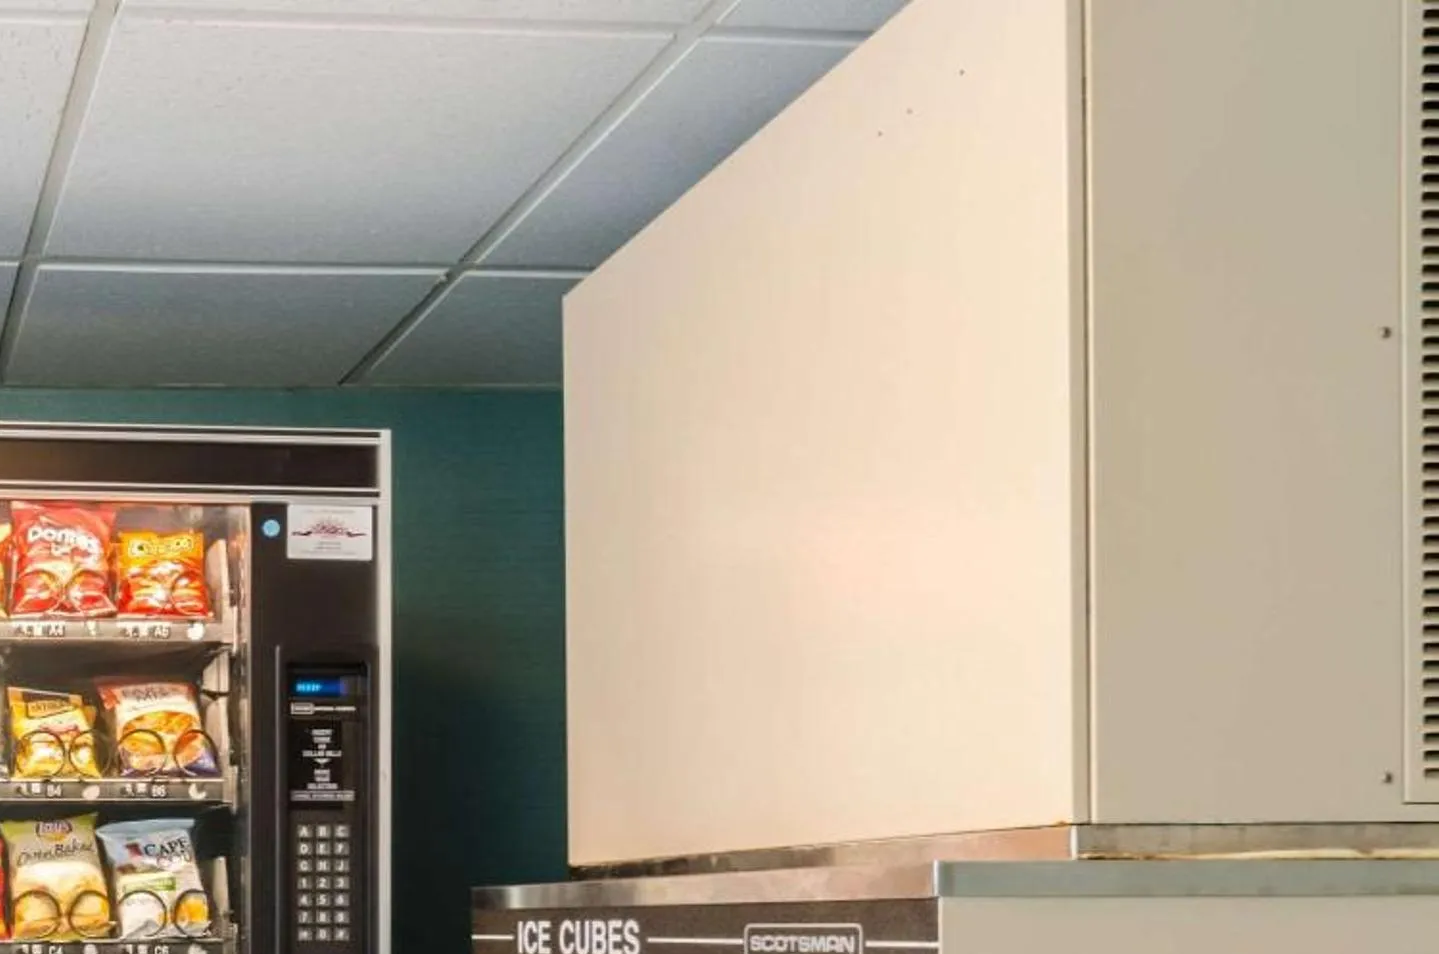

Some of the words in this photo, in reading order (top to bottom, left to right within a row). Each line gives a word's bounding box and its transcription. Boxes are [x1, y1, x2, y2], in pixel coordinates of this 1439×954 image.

[143, 837, 187, 857] CAPE
[517, 920, 552, 954] ICE
[749, 935, 855, 953] SCOTSMAN
